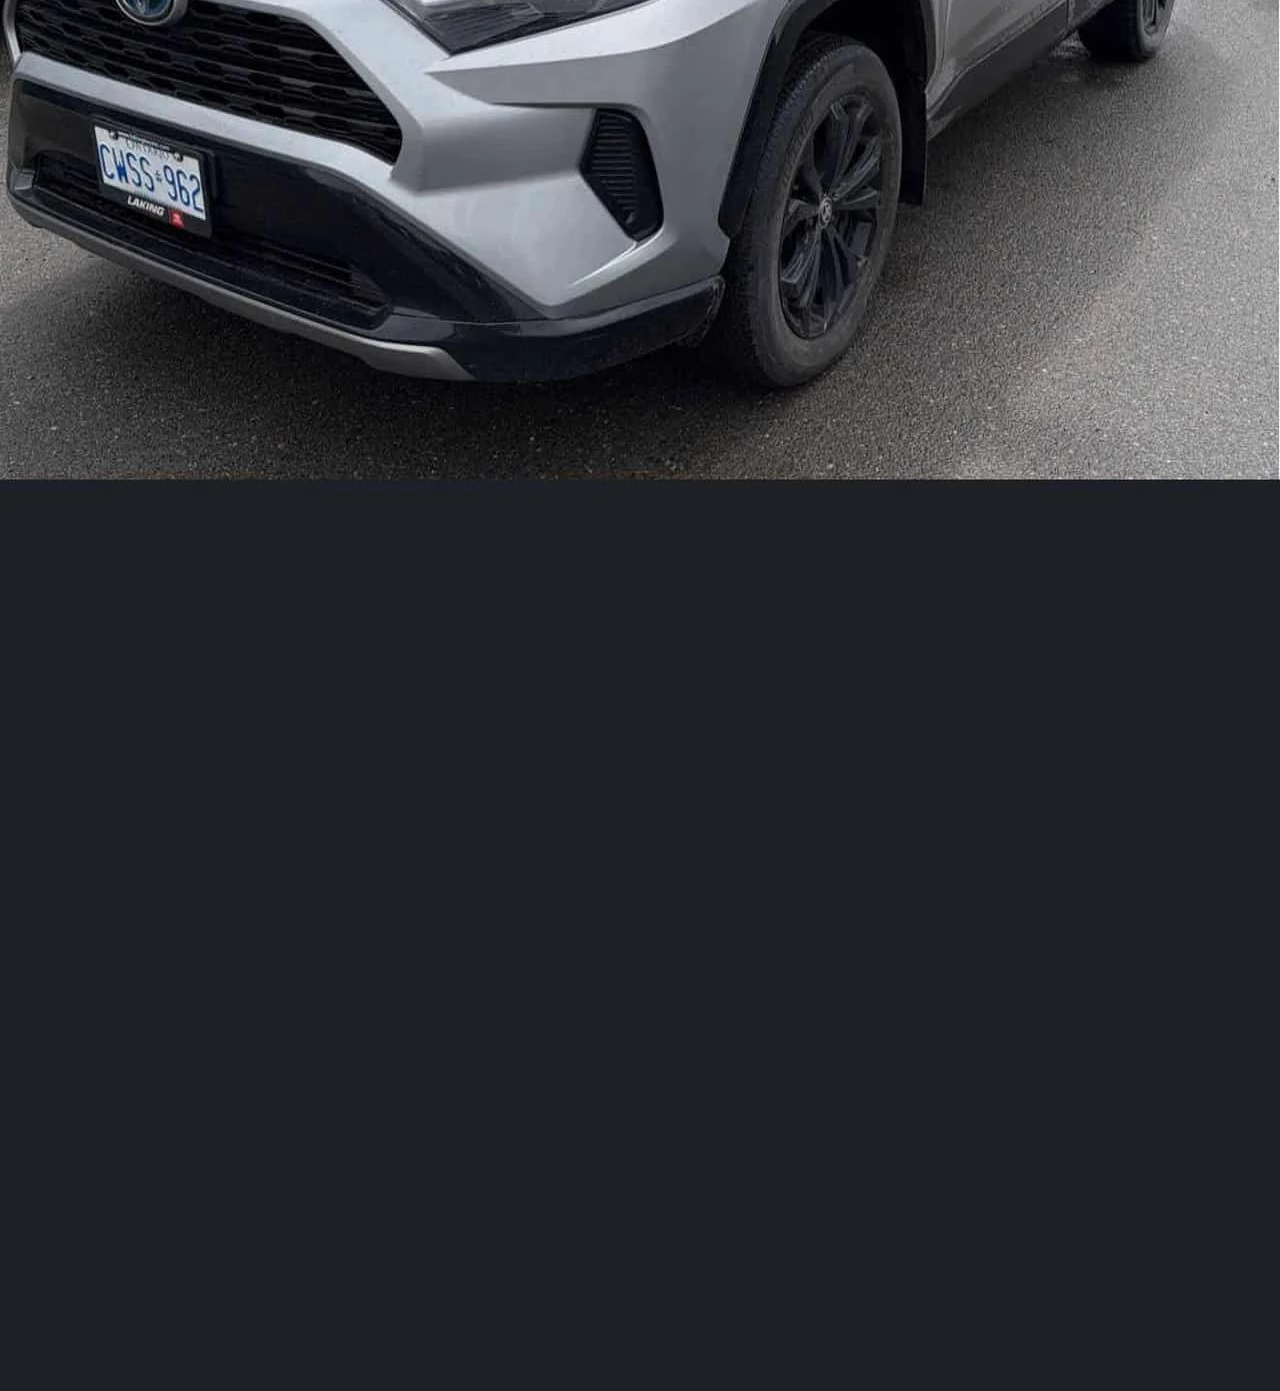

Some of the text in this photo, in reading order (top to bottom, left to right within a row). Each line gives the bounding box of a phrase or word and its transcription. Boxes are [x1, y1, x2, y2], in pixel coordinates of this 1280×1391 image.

[100, 144, 204, 212] CWSS 962
[127, 194, 165, 217] LAKING
